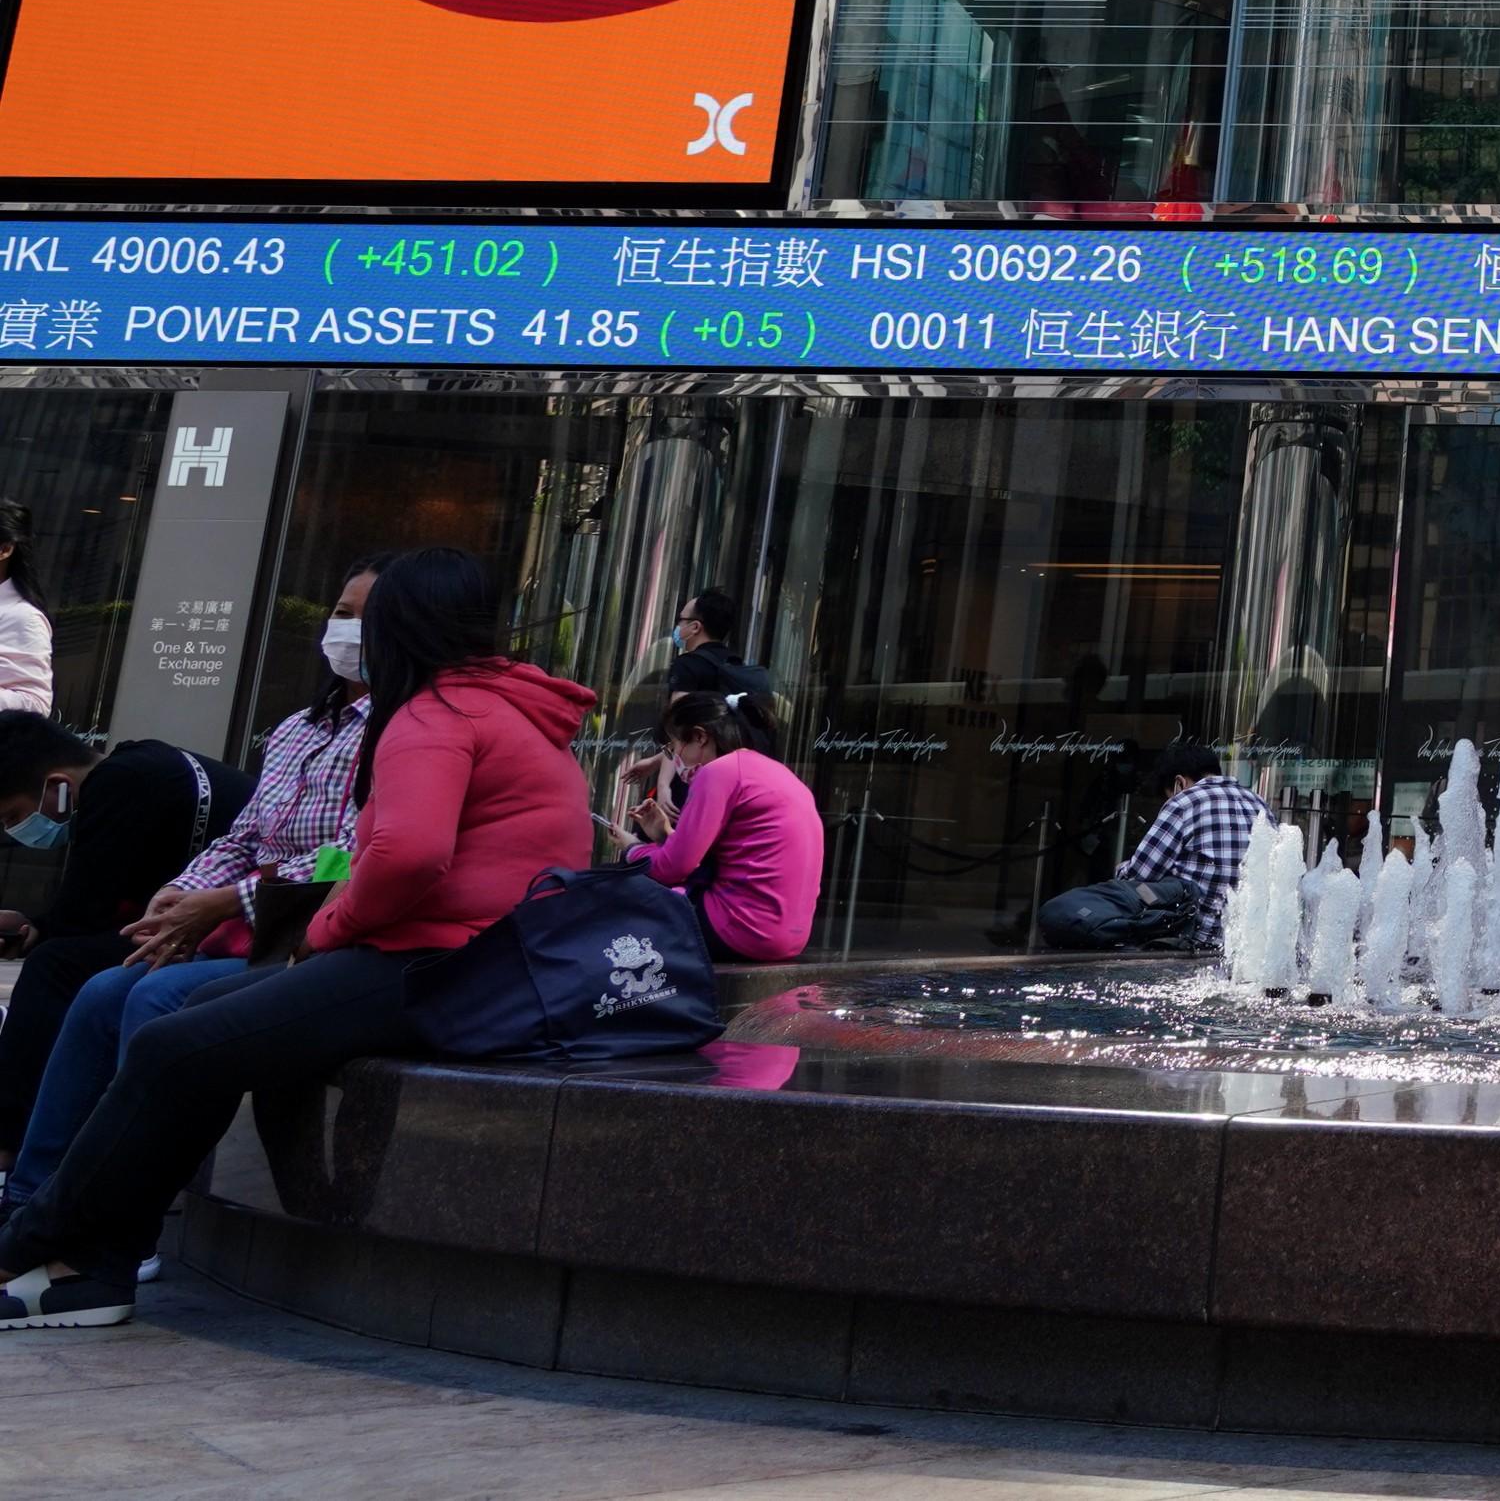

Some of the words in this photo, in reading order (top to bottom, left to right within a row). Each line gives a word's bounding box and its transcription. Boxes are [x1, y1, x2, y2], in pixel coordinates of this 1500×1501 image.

[92, 236, 286, 276] 49006.43
[613, 236, 829, 289] 恒生指數
[850, 244, 927, 282] HSI
[948, 244, 1143, 284] 30692.26
[125, 306, 299, 346] POWER
[309, 308, 497, 347] ASSETS
[522, 310, 641, 348] 41.85
[870, 312, 996, 351] 00011
[1021, 308, 1240, 362] 恒生銀行
[1262, 317, 1396, 355] HANG
[153, 641, 181, 654] One
[184, 641, 195, 654] &
[199, 641, 226, 654] Two
[158, 656, 223, 673] Exchange
[172, 672, 221, 688] Square
